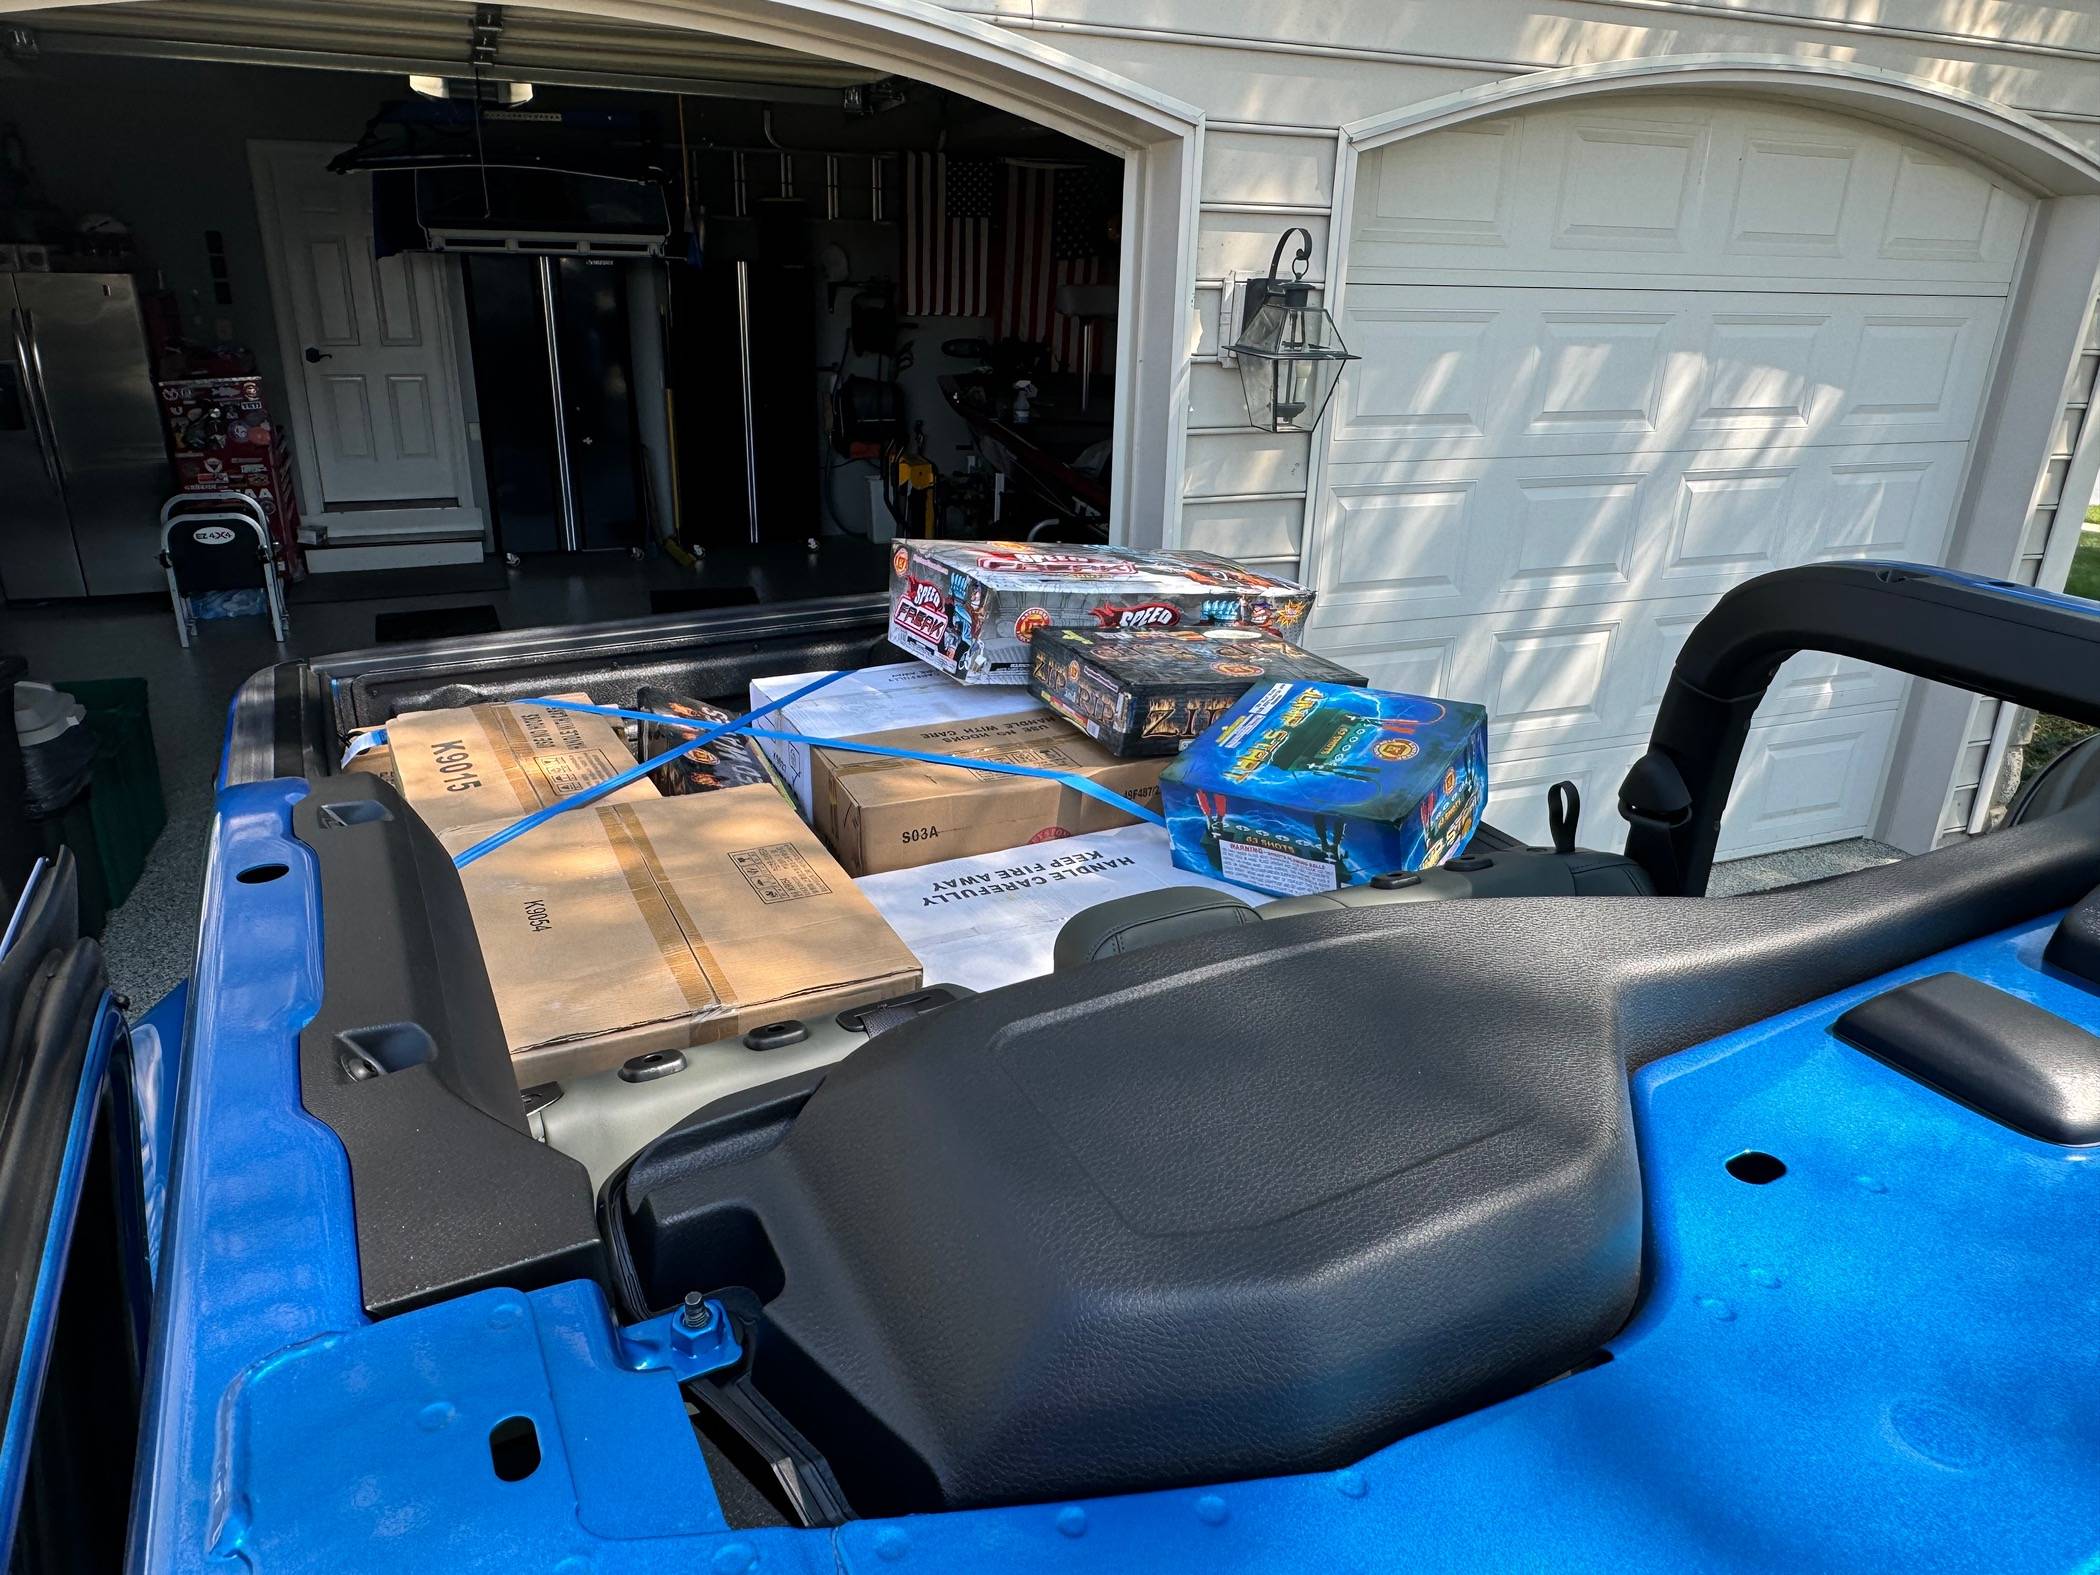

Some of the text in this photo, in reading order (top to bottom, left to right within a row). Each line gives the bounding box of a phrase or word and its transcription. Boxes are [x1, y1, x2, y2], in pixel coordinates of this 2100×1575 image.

[913, 583, 940, 609] SPEED
[1118, 607, 1172, 627] SPEED
[963, 723, 998, 733] WITH
[1021, 725, 1049, 733] USE
[431, 739, 482, 793] K9015
[1223, 730, 1289, 783] START
[901, 825, 940, 845] S03A
[1230, 843, 1263, 854] WARNING
[923, 856, 1136, 907] HANDLE CAREFULLY
[932, 850, 1104, 892] KEEP FIRE AWAY
[523, 899, 552, 933] K9054
